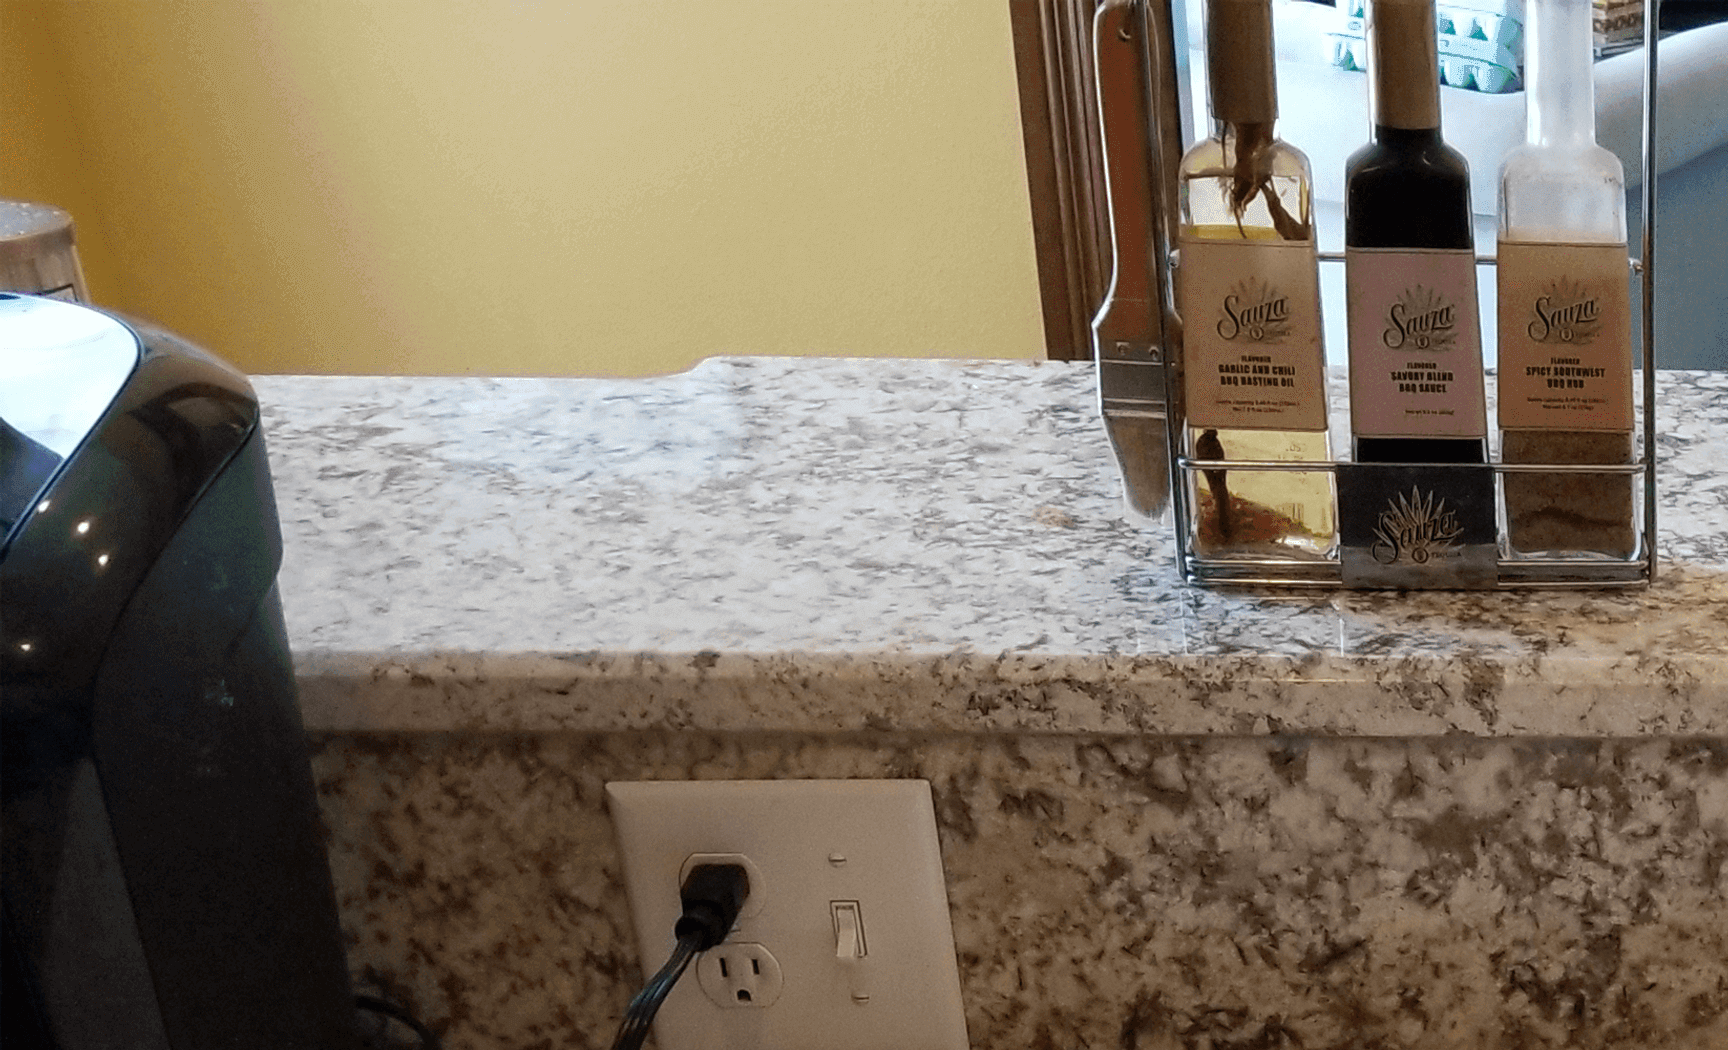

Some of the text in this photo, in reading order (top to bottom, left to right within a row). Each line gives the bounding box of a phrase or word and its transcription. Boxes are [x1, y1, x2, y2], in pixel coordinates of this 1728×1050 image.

[1217, 294, 1290, 341] Sauza
[1528, 296, 1600, 342] Sauza
[1383, 303, 1455, 349] Sauza
[1218, 364, 1295, 376] GARLIC AND CHILI
[1526, 366, 1606, 378] SPICY SOUTHWEST
[1220, 376, 1295, 387] BBQ BASTING OIL
[1391, 371, 1454, 382] SAVORY BLEND
[1399, 383, 1447, 393] BBQ SAUCE
[1547, 379, 1584, 389] BBQ RUB
[1371, 510, 1459, 565] Sauza
